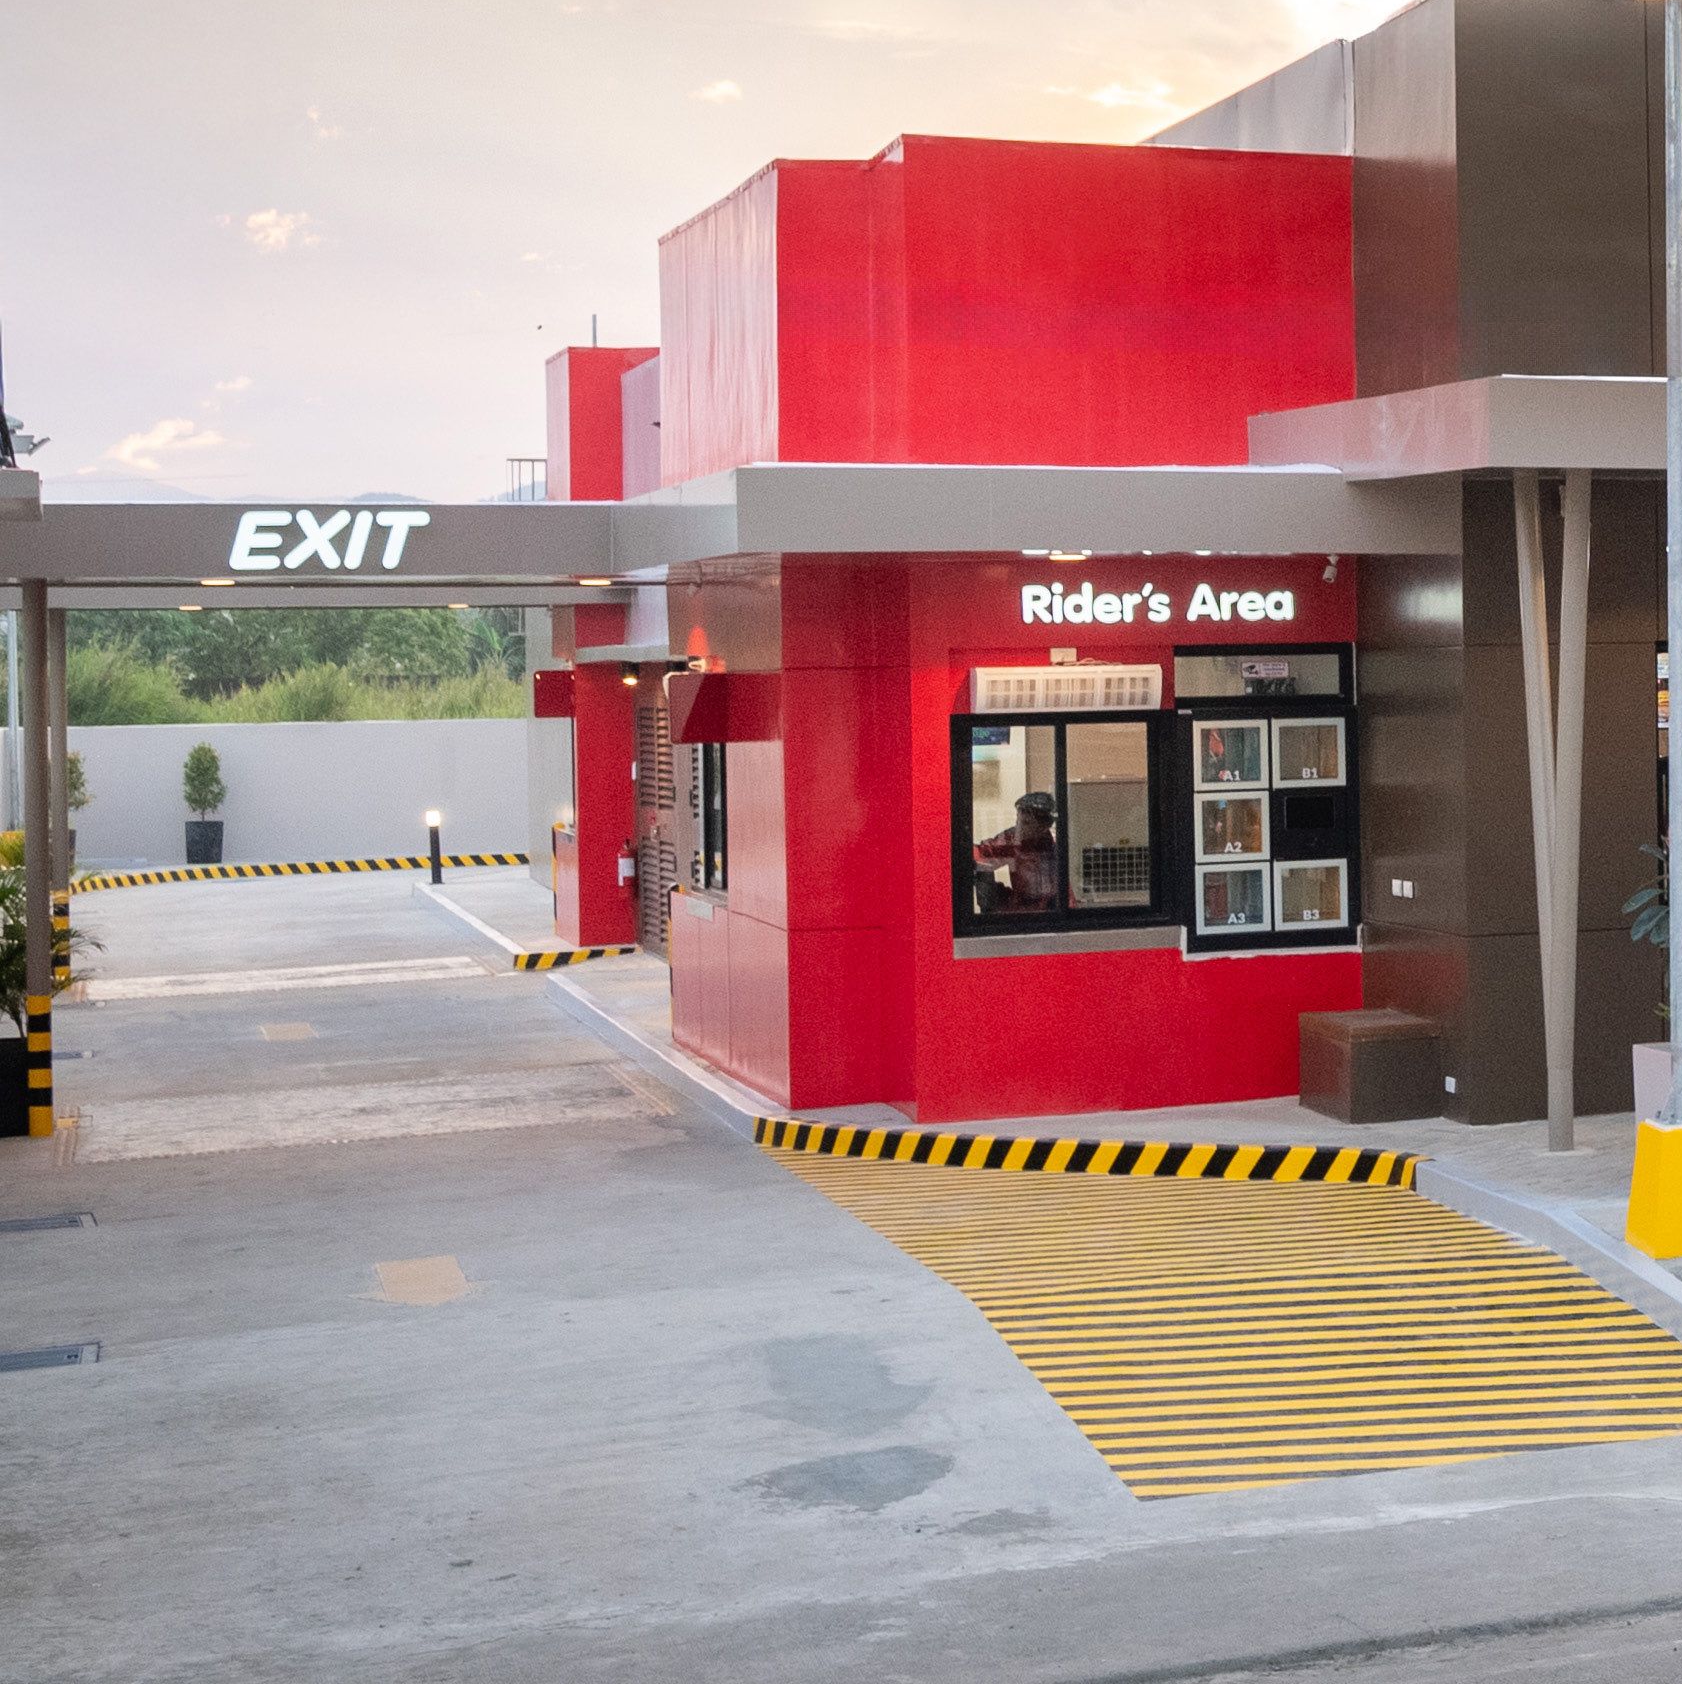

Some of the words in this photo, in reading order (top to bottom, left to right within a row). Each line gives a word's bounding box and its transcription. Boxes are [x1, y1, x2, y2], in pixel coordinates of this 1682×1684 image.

[229, 509, 431, 570] EXIT
[1021, 582, 1171, 624] Rider's
[1187, 583, 1294, 621] Area
[1223, 770, 1241, 781] A1
[1302, 768, 1318, 779] B1
[1224, 842, 1242, 853] A2
[1227, 912, 1246, 924] A3
